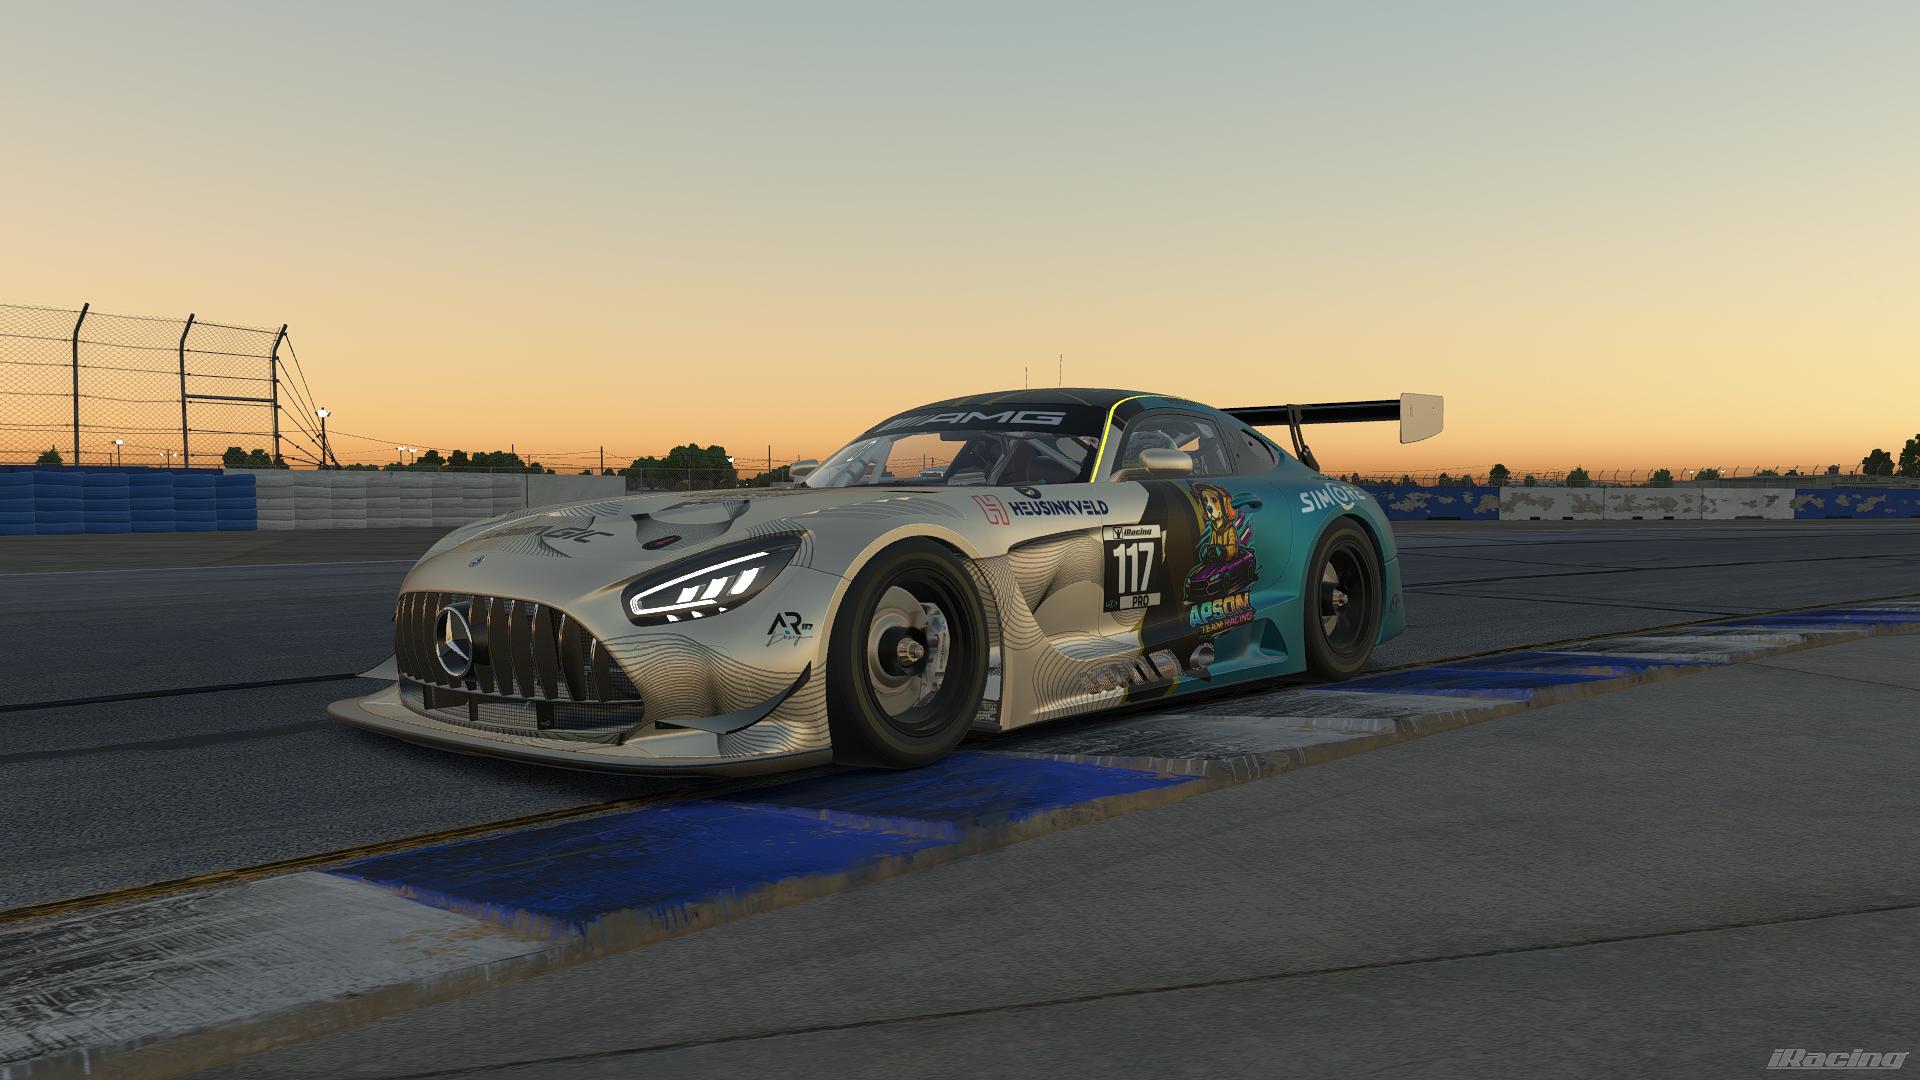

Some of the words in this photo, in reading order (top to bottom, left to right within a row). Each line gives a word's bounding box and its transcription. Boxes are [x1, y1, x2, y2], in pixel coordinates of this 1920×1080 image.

[917, 411, 1066, 426] AMG
[1008, 500, 1109, 516] HEUSINKVELD
[1112, 541, 1155, 594] 117
[1132, 595, 1150, 607] PRO
[1189, 592, 1251, 627] APSON
[1200, 621, 1224, 634] TEAM
[1224, 612, 1253, 627] RACING
